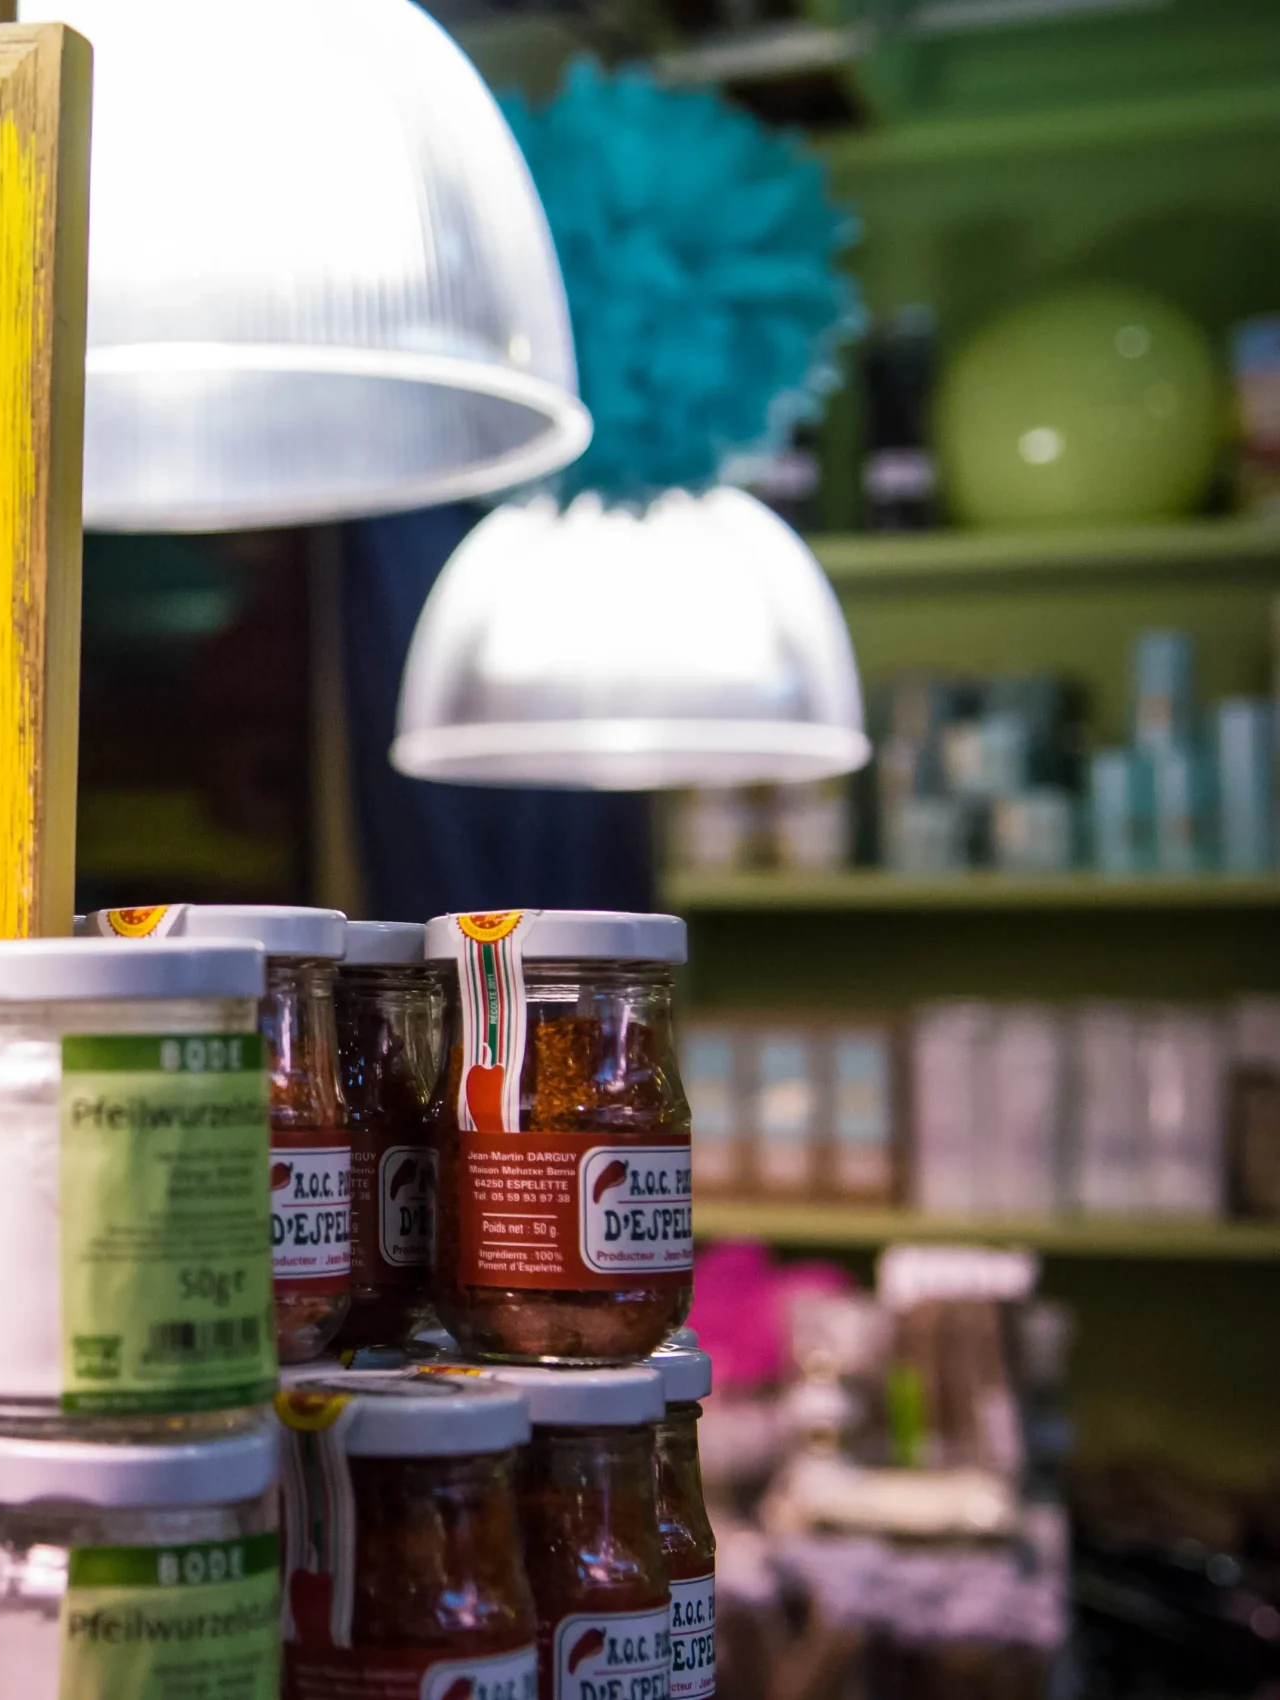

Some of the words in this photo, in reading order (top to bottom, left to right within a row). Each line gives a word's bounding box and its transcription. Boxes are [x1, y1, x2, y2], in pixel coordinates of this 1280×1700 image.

[468, 1151, 524, 1161] Jean-Martin
[527, 1152, 577, 1163] DARGUY
[469, 1165, 500, 1175] Maison
[294, 1171, 334, 1199] A.O.C.
[475, 1179, 504, 1189] 64250
[507, 1180, 569, 1191] ESPELETTE
[630, 1170, 671, 1196] A.O.C.
[491, 1192, 504, 1202] 05
[507, 1193, 520, 1203] 59
[524, 1193, 537, 1203] 93
[540, 1193, 553, 1203] 97
[558, 1193, 571, 1204] 38
[483, 1220, 506, 1234] Poids
[509, 1223, 524, 1235] net
[533, 1222, 547, 1235] 50
[480, 1249, 528, 1262] Ingrédients
[535, 1250, 564, 1262] 100%
[597, 1250, 655, 1261] Producteur
[479, 1260, 507, 1271] Piment
[672, 1600, 705, 1627] A.O.C.
[607, 1636, 649, 1665] A.O.C.
